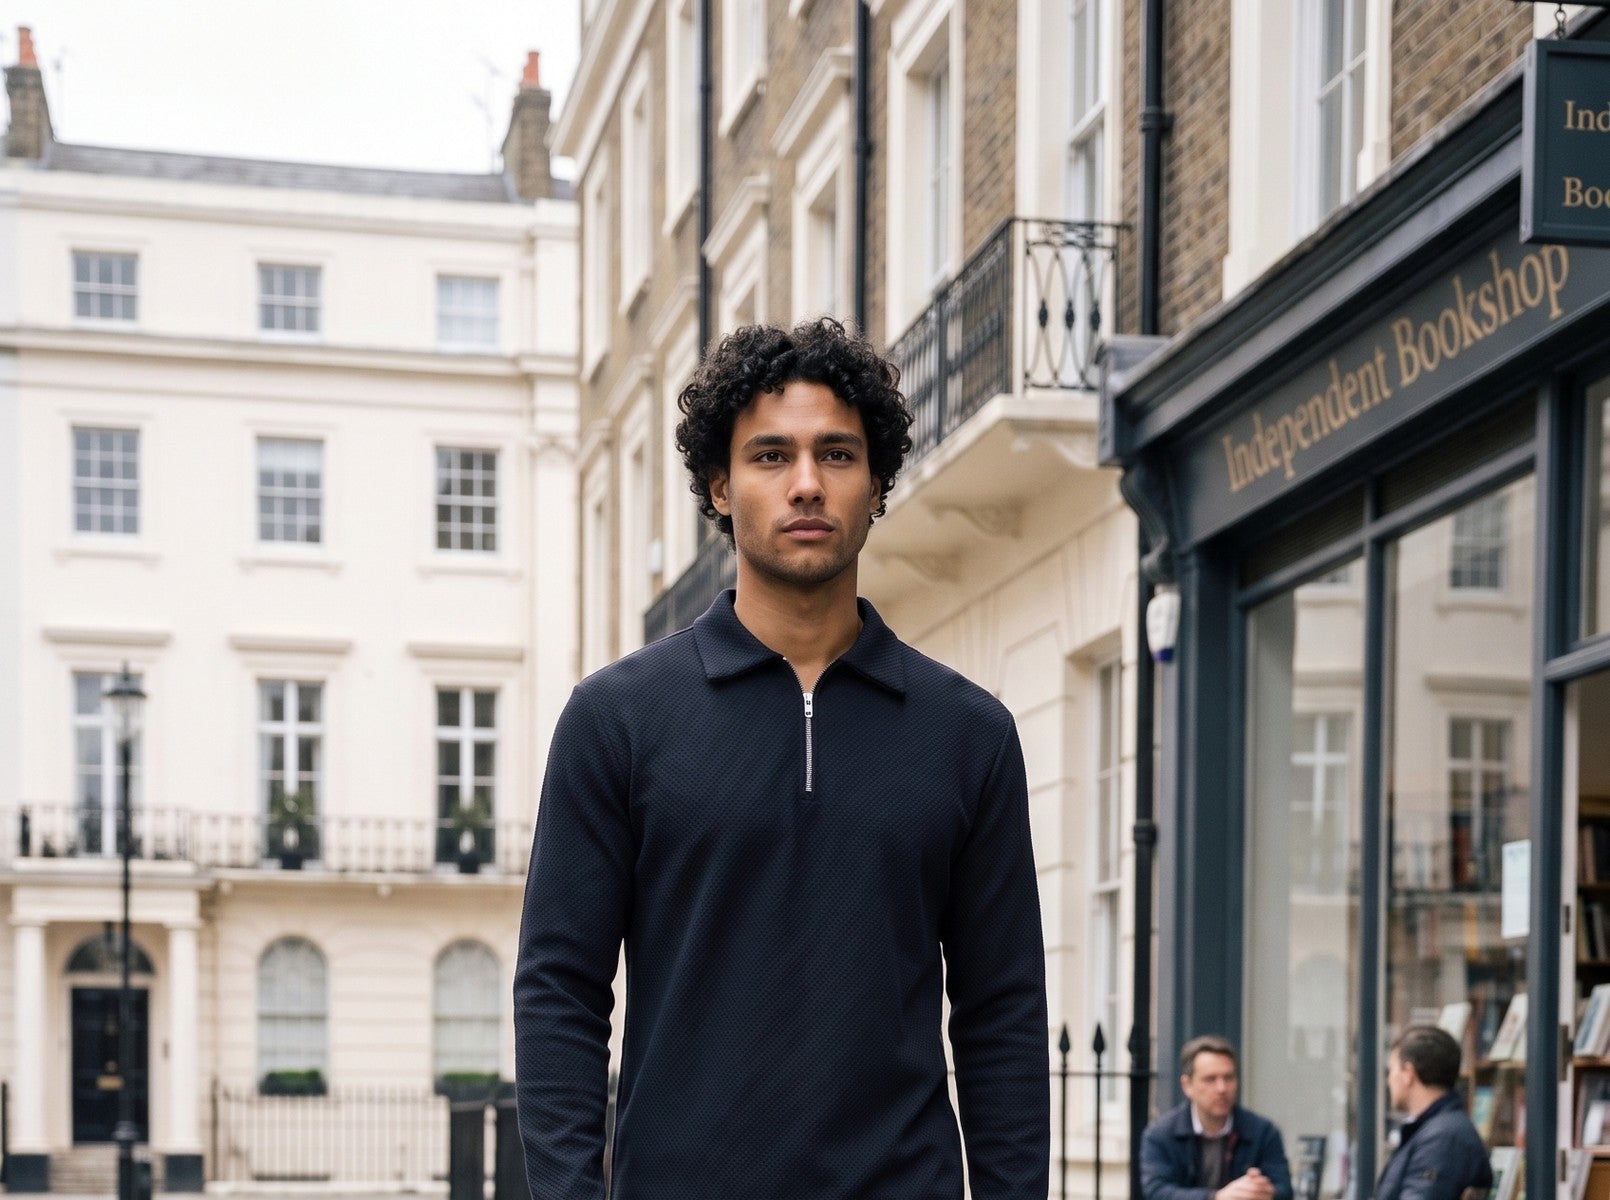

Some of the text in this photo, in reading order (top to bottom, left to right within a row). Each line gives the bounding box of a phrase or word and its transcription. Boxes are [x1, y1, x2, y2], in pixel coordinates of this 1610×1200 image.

[1564, 176, 1610, 209] Bo
[1222, 243, 1570, 492] Independent Bookshop
